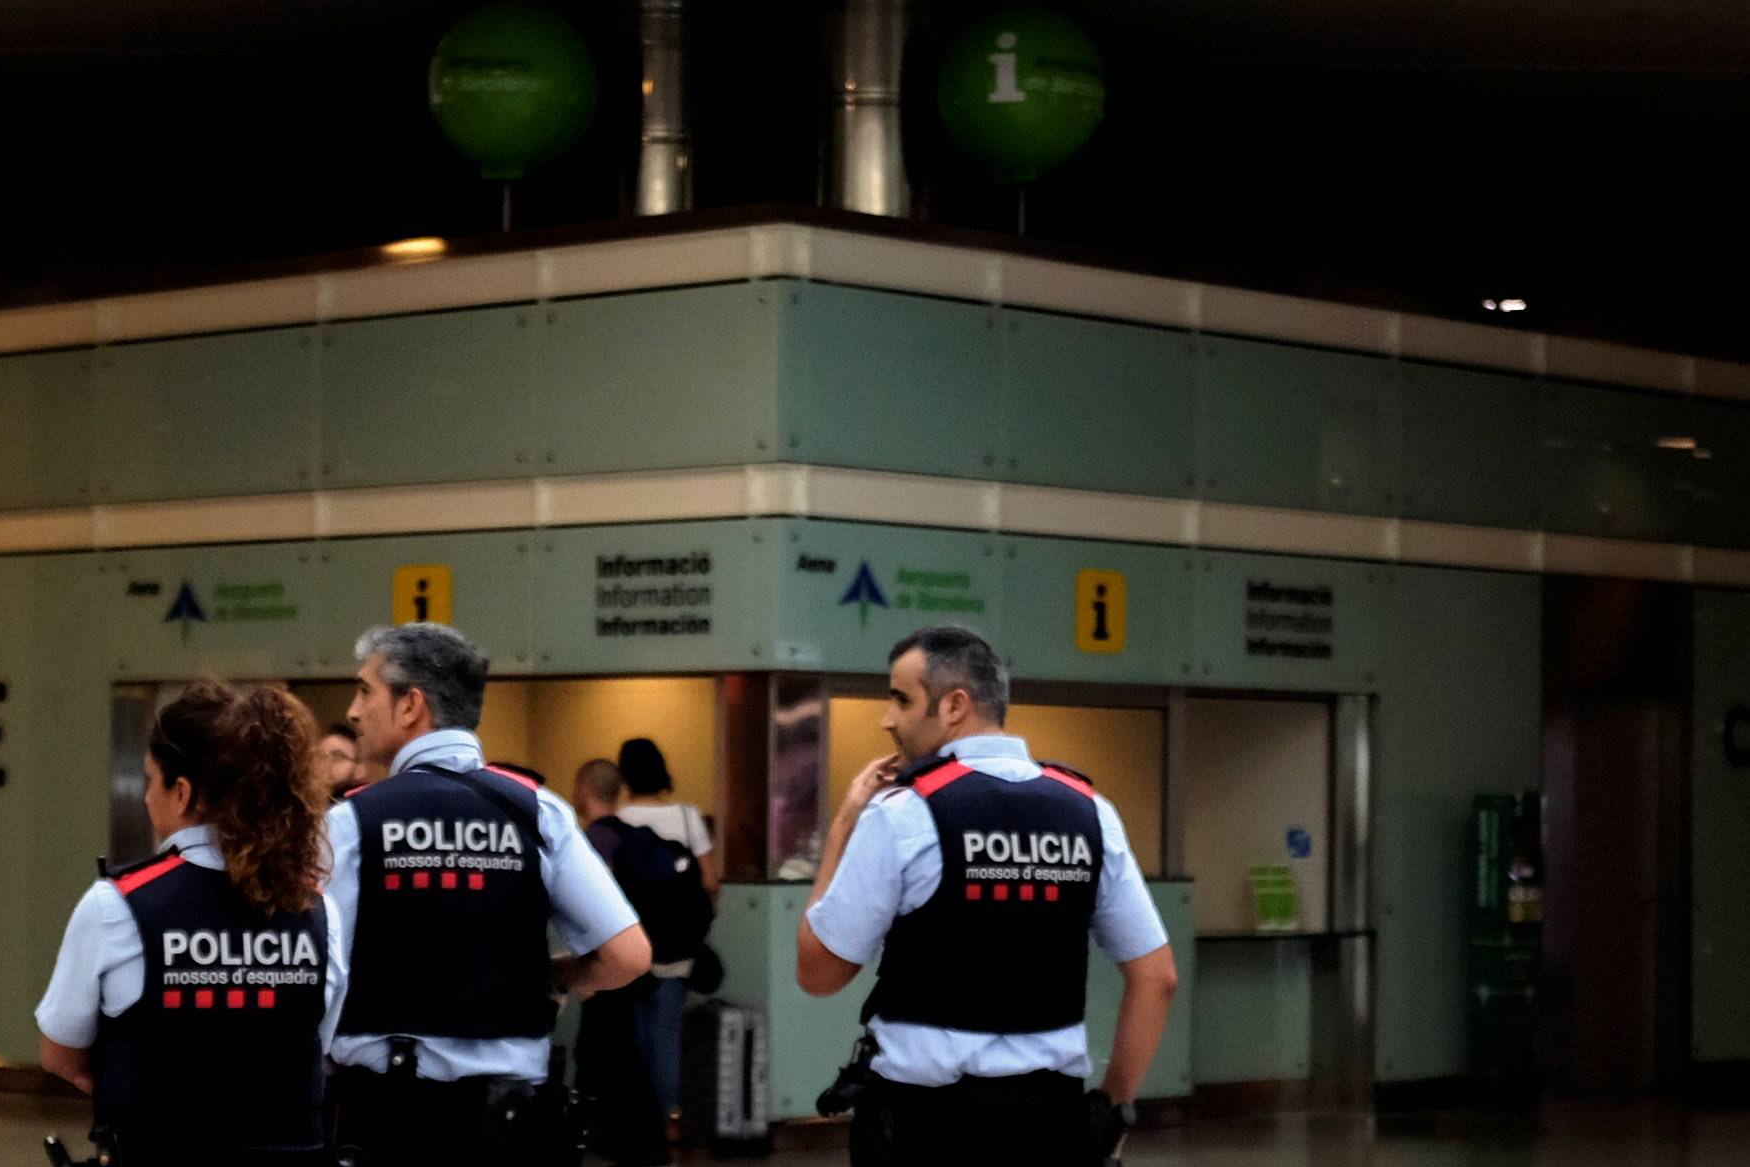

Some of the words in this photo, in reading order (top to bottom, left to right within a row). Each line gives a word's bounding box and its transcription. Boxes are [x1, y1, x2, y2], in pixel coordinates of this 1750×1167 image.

[596, 584, 711, 608] Information
[382, 819, 523, 855] POLICIA
[963, 831, 1093, 867] POLICIA
[384, 855, 442, 869] mossos
[965, 866, 1020, 881] mossos
[162, 930, 319, 967] POLICIA
[163, 970, 229, 985] mossos
